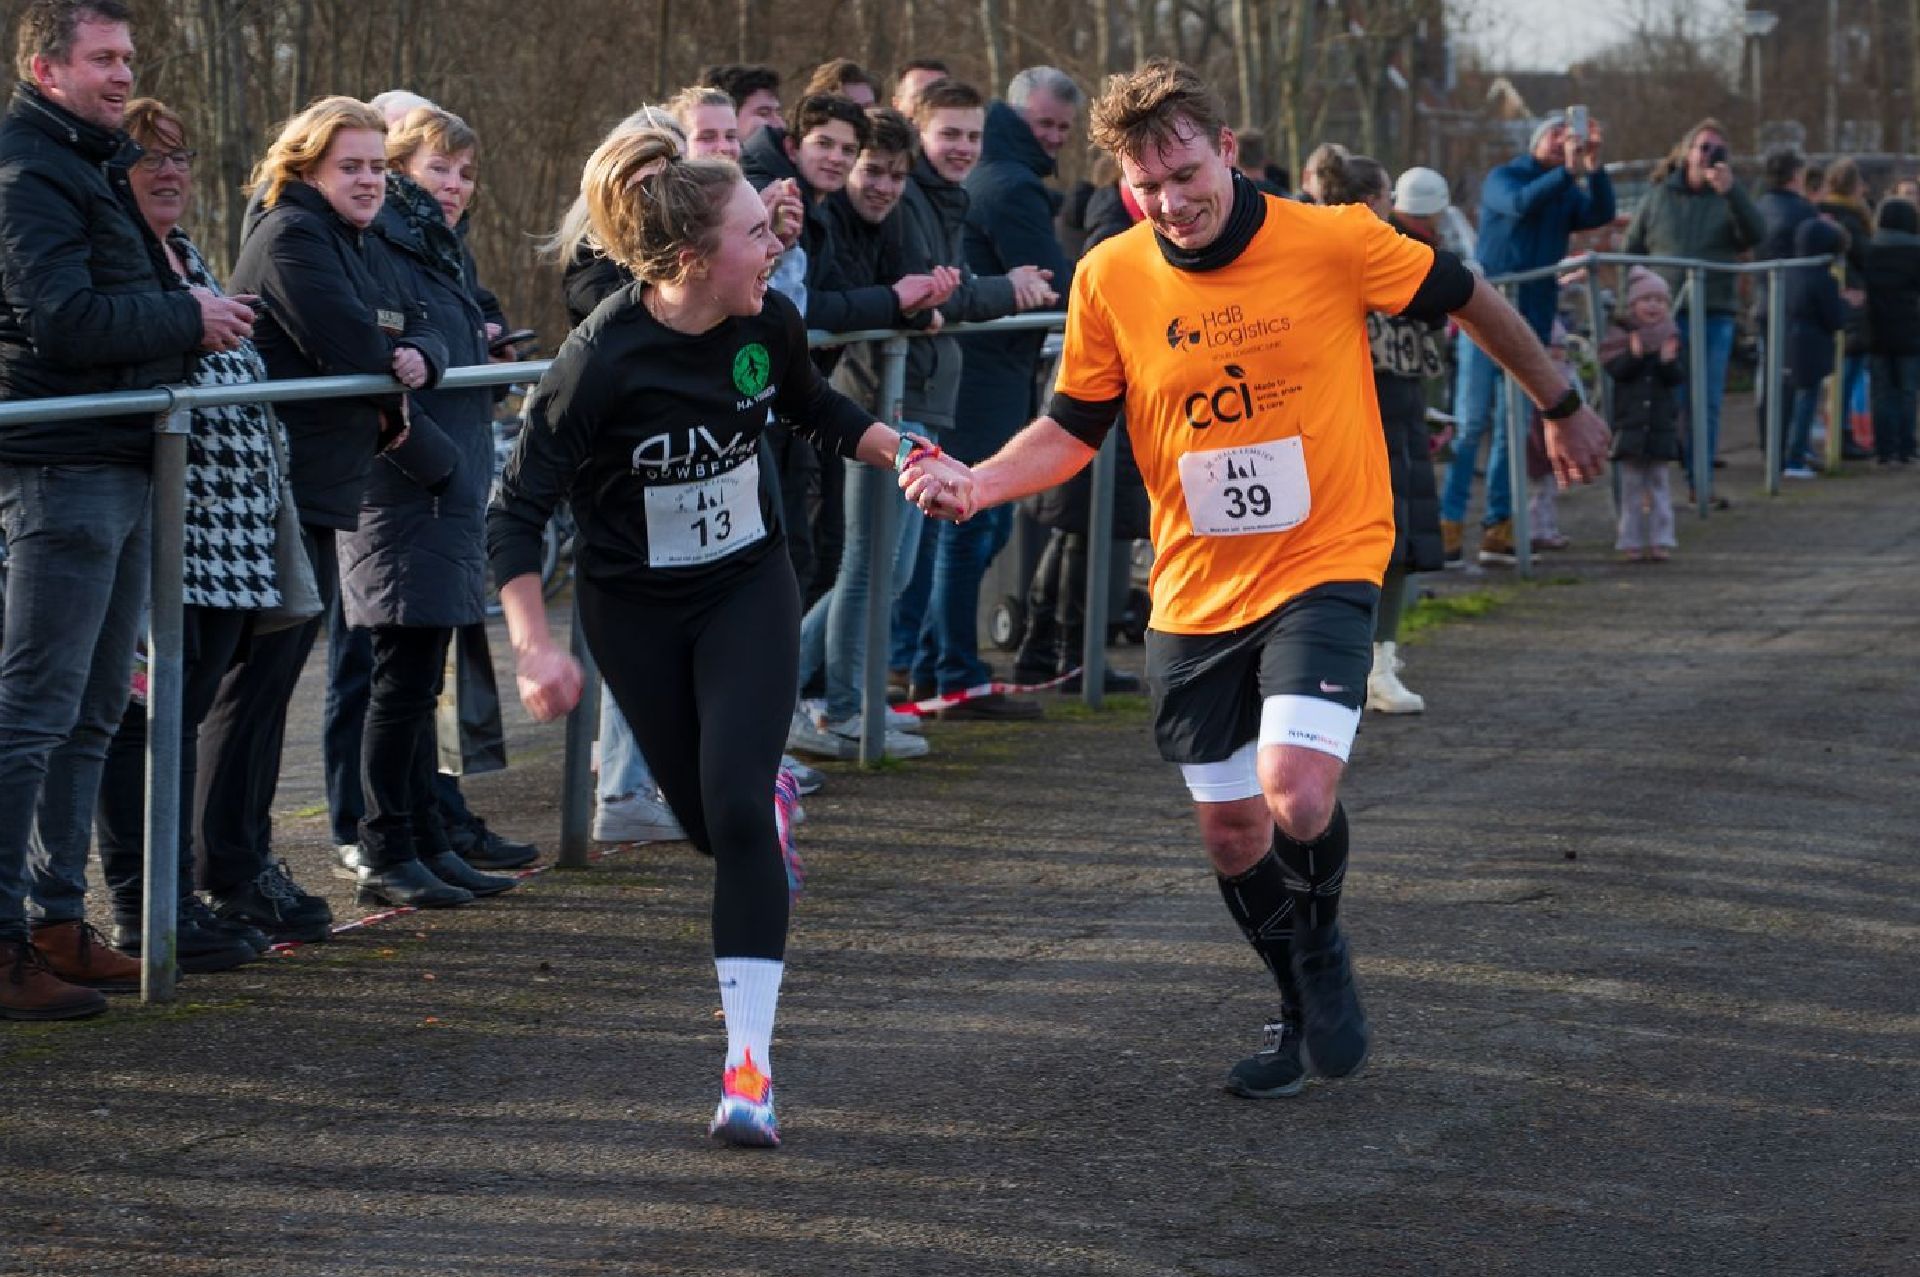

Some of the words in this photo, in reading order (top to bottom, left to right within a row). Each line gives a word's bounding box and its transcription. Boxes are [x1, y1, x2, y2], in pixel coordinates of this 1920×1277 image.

[1202, 305, 1243, 327] HdB
[1204, 317, 1291, 348] Logistics
[1223, 485, 1271, 519] 39
[691, 510, 731, 547] 13
